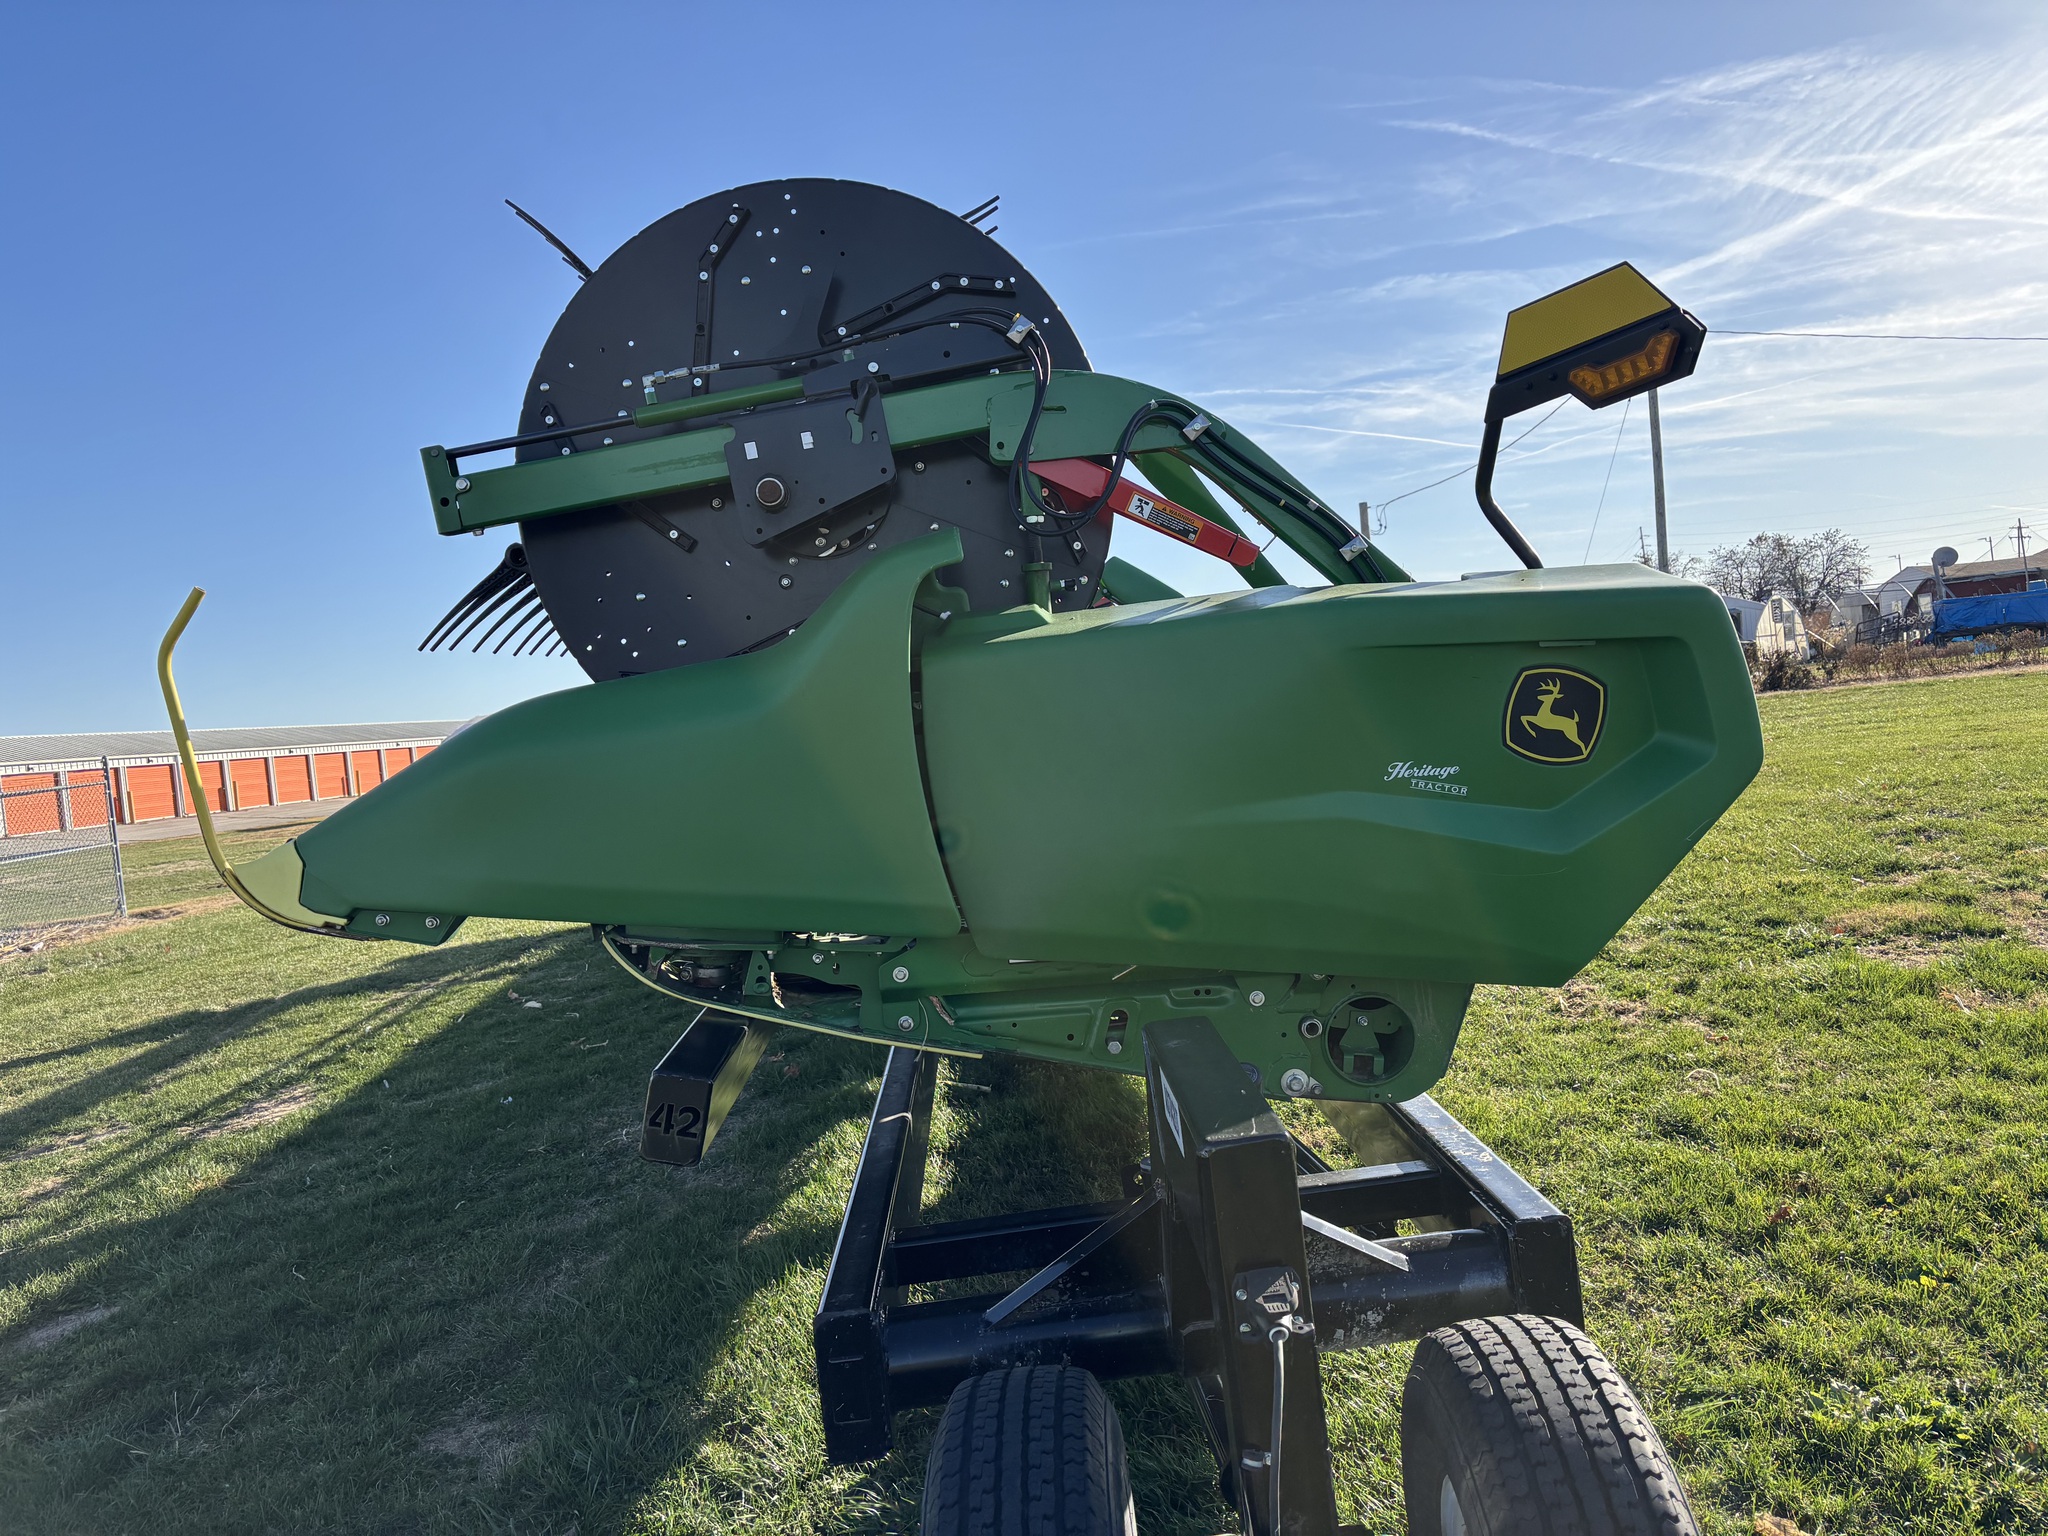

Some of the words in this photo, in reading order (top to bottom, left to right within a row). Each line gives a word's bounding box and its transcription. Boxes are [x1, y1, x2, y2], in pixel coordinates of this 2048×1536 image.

[1168, 508, 1196, 525] WARNING
[1384, 760, 1460, 781] Heritage
[1411, 780, 1468, 795] TRACTOR
[648, 1102, 701, 1139] 42
